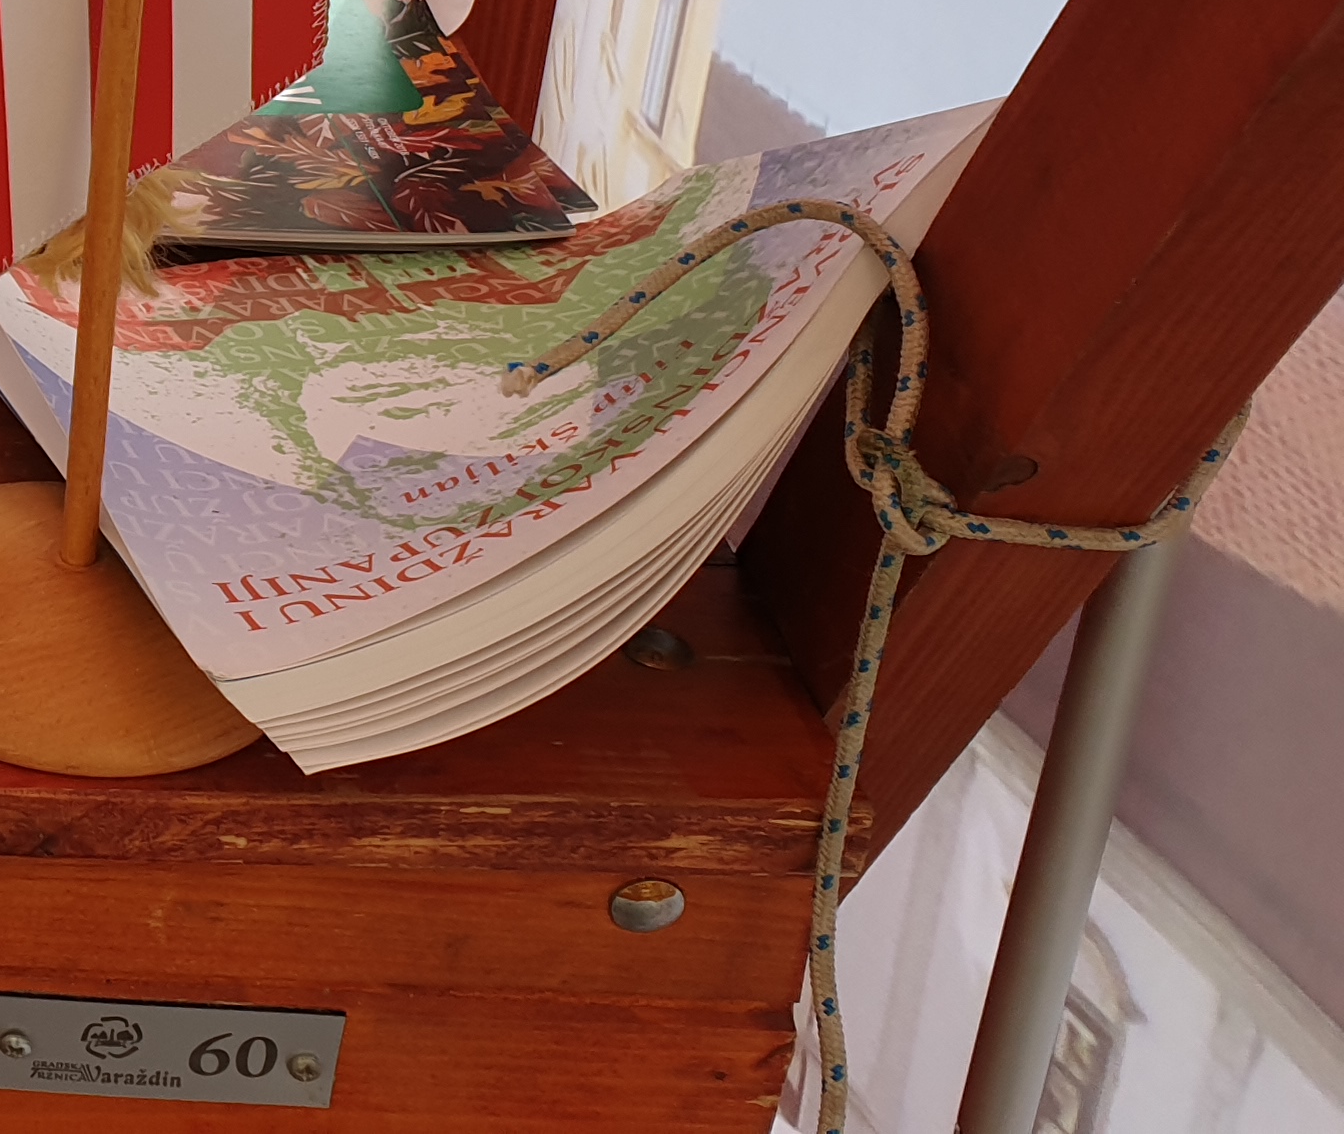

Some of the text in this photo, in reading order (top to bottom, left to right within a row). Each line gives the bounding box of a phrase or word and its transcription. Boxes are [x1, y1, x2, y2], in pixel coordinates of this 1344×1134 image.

[652, 408, 692, 435] U
[399, 421, 580, 509] Škiljan
[210, 505, 506, 604] ŽUPANIJI
[278, 451, 642, 627] VARAŽDINU
[234, 610, 267, 632] I
[85, 1064, 182, 1088] Varaždin
[187, 1032, 279, 1079] 60
